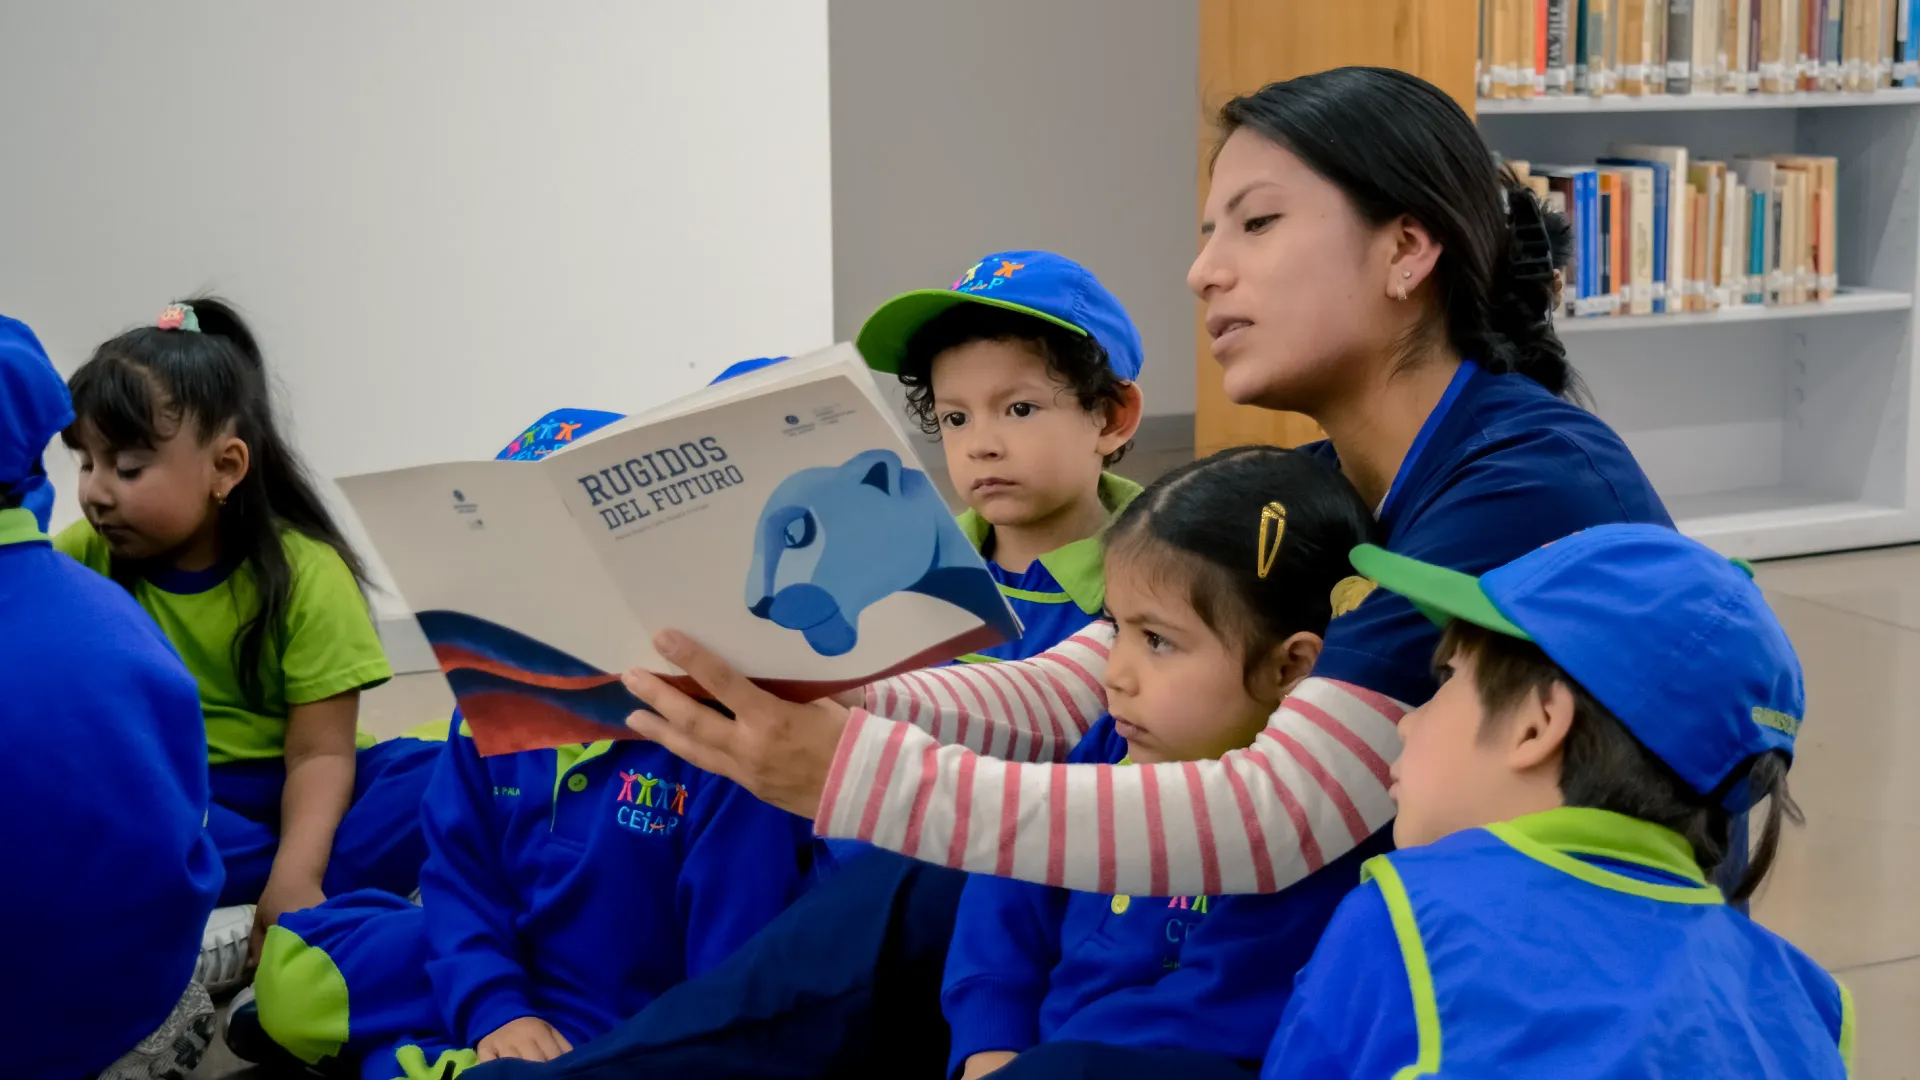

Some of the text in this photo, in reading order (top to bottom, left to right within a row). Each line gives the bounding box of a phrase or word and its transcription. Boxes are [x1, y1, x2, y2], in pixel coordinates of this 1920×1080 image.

[578, 436, 728, 506] RUGIDOS
[599, 498, 651, 530] DEL
[647, 464, 744, 512] FUTURO
